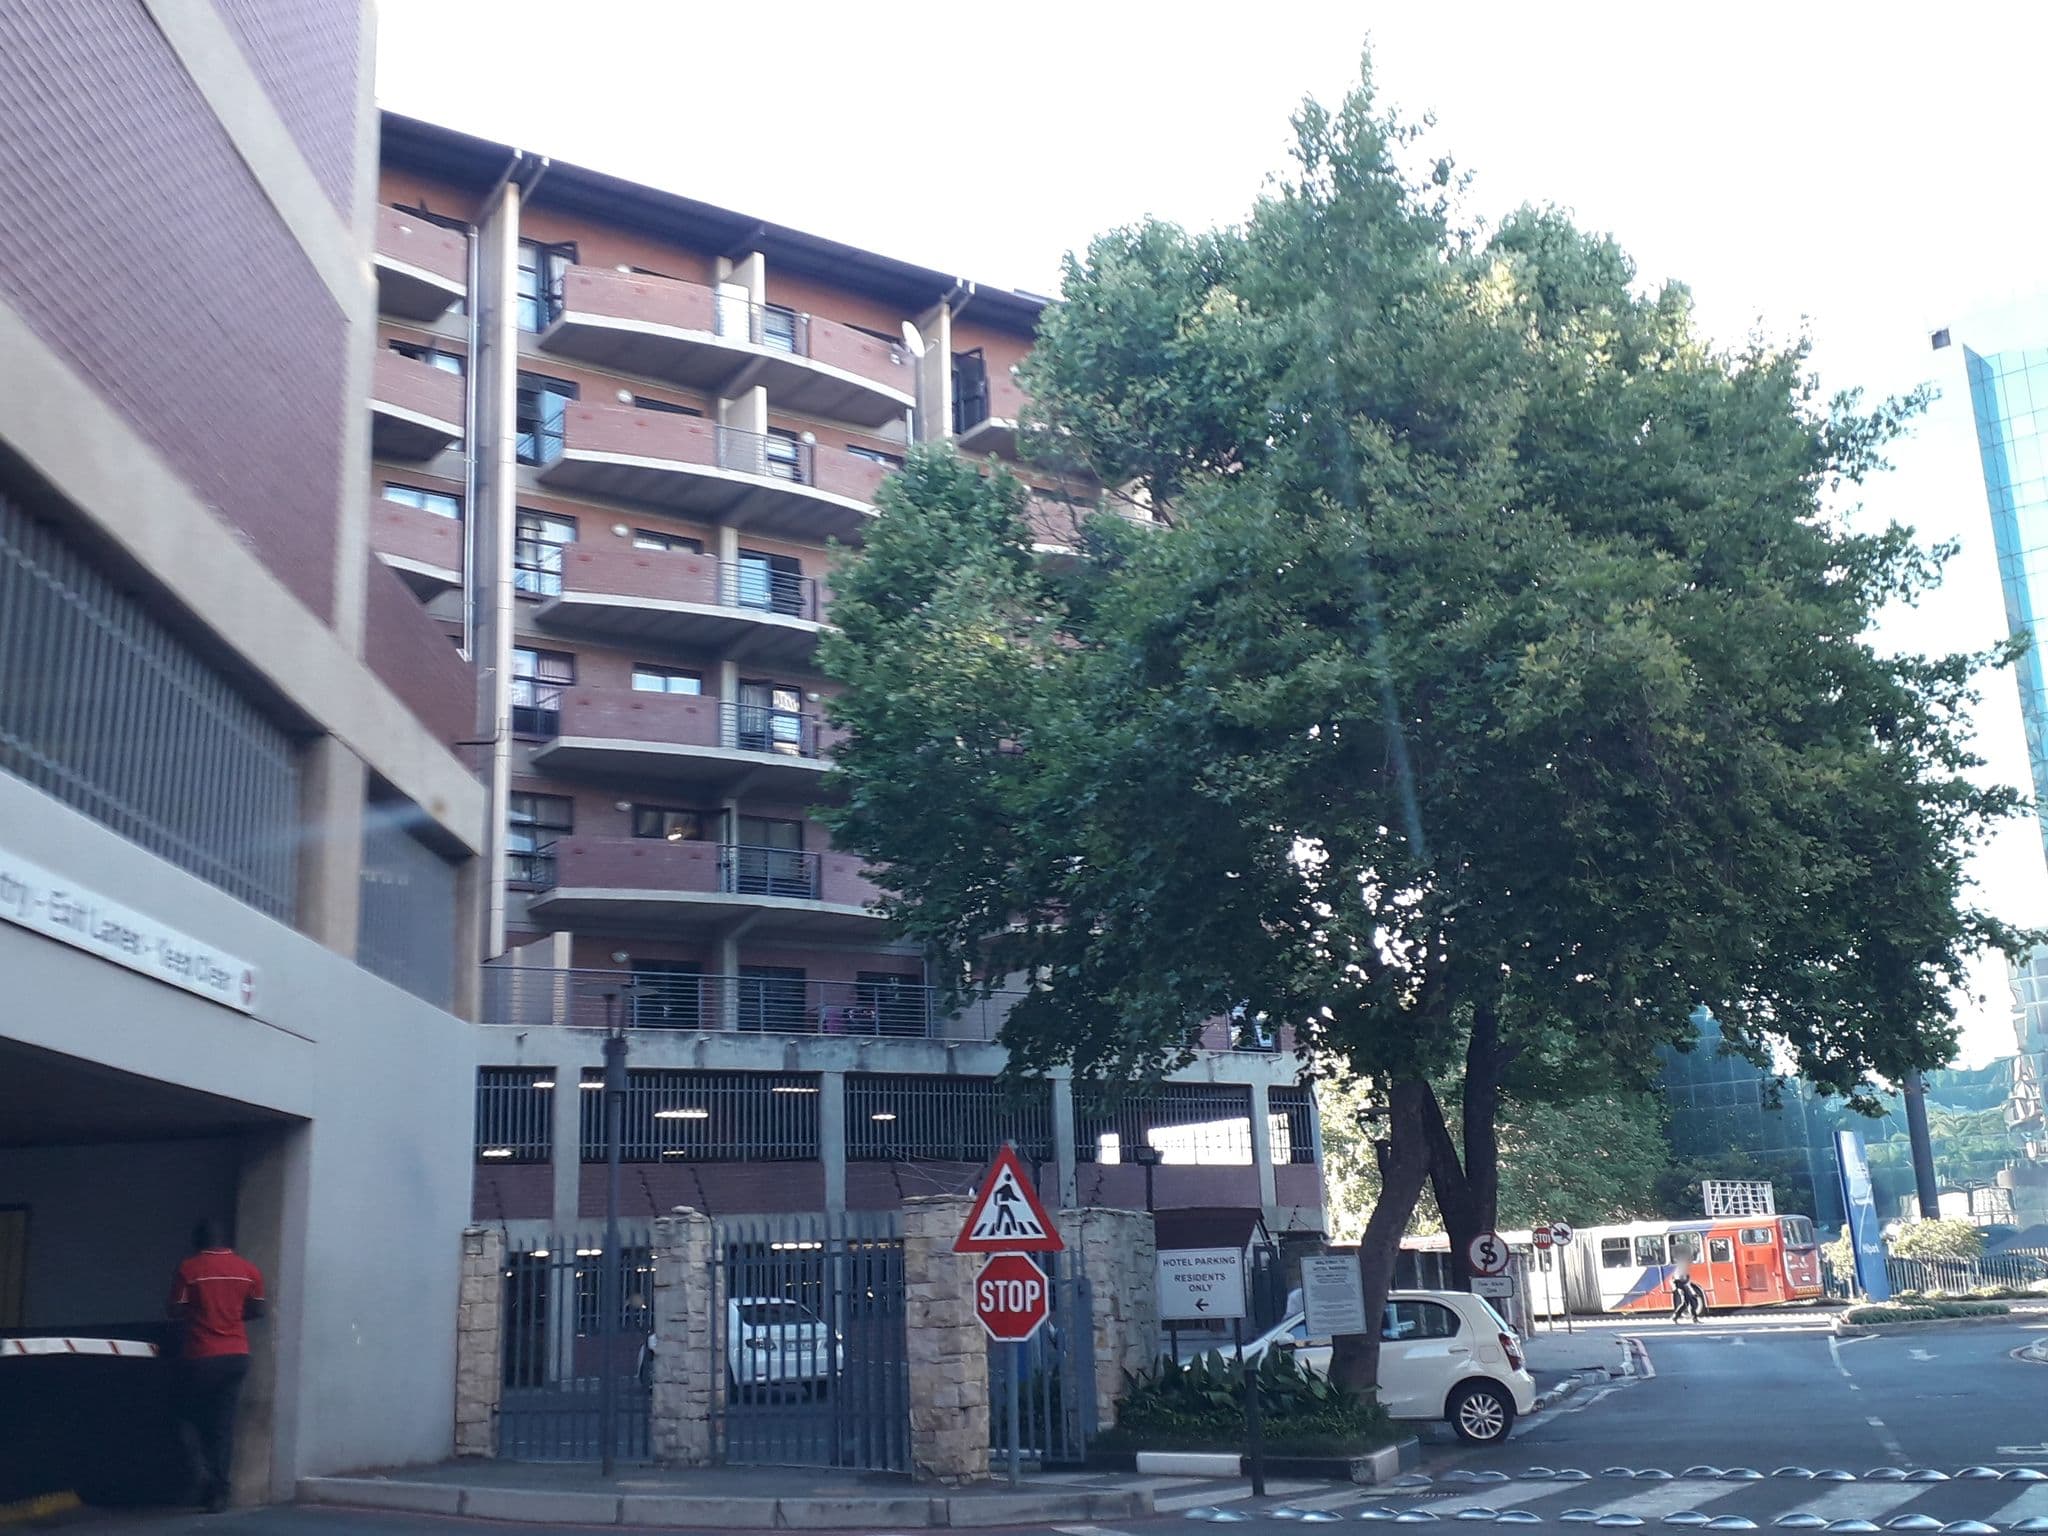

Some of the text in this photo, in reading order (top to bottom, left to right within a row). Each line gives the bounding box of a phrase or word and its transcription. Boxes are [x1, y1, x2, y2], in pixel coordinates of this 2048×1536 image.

[1162, 1256, 1236, 1267] HOTEL PARKING
[1174, 1272, 1227, 1282] RESIDENTS
[1188, 1284, 1213, 1292] ONLY
[980, 1280, 1041, 1313] STOP
